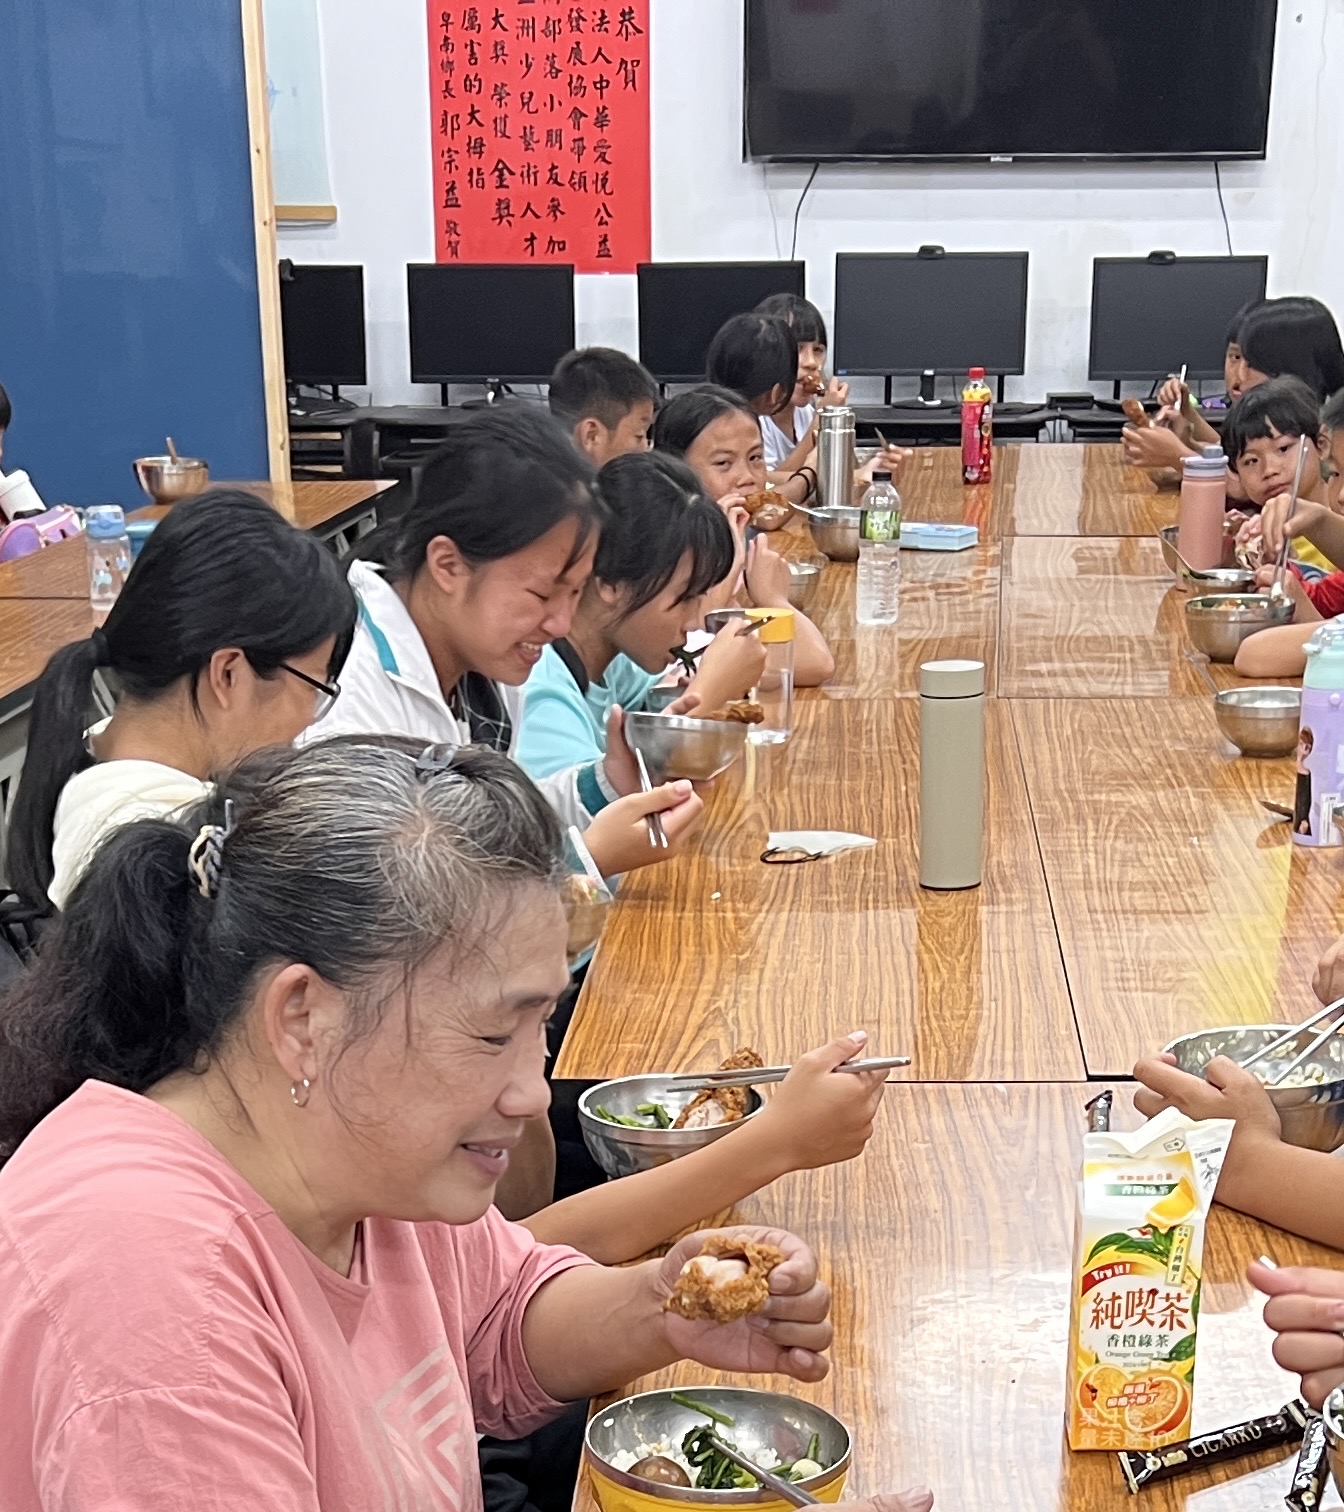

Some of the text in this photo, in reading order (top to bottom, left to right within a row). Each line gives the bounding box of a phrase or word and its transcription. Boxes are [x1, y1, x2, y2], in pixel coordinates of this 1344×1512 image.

[615, 6, 644, 92] 恭賀
[516, 0, 542, 257] 洲少兒藝術人才
[540, 0, 567, 255] 部落小朋友參加
[1089, 1287, 1190, 1332] 純喫茶
[1106, 1333, 1171, 1348] 香橙綠茶
